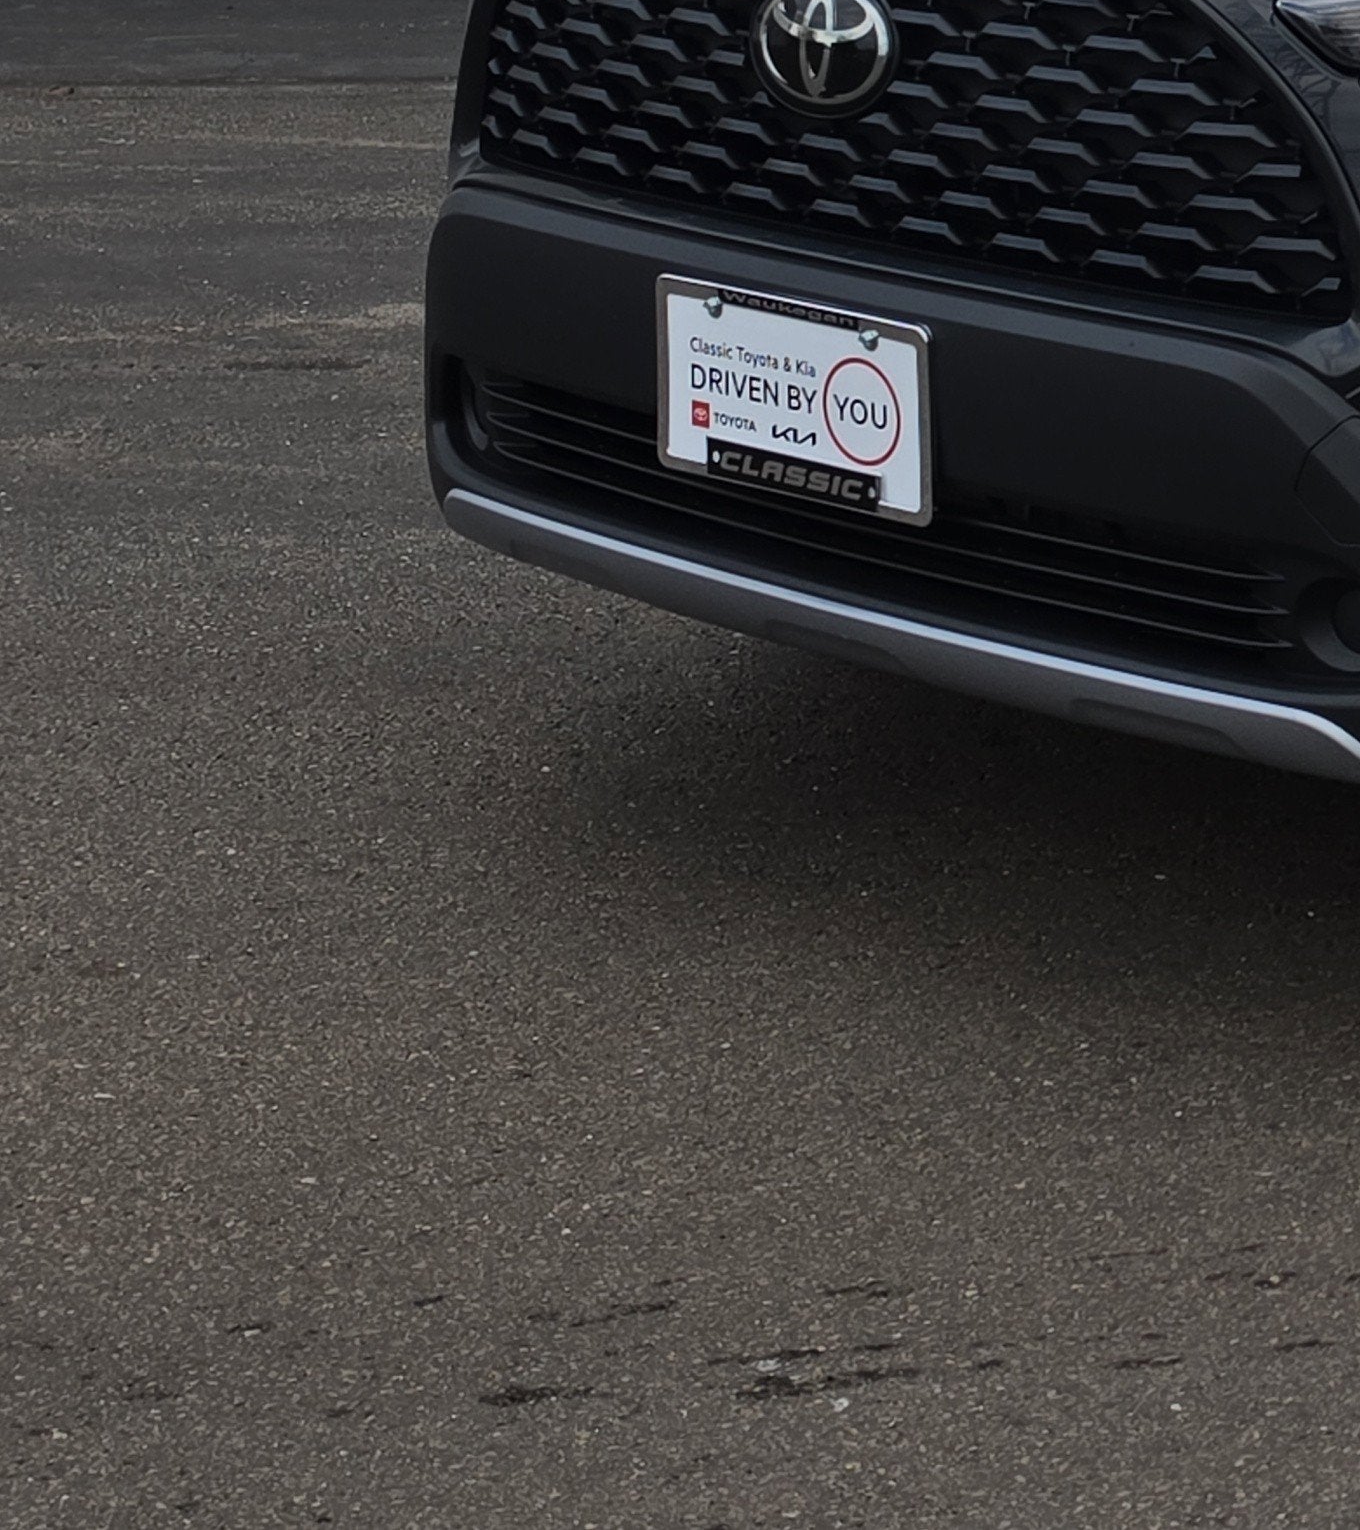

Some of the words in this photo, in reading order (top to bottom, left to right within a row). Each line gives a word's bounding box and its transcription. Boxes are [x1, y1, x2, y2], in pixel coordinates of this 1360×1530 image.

[721, 289, 857, 327] Waukegan
[689, 336, 733, 361] Classic
[736, 346, 779, 370] Toyota
[782, 356, 792, 372] &
[796, 360, 817, 378] Kia
[690, 364, 779, 407] DRIVEN
[787, 384, 818, 414] BY
[714, 412, 757, 432] TOYOTA
[833, 393, 888, 430] YOU
[719, 450, 865, 501] CLASSIC
